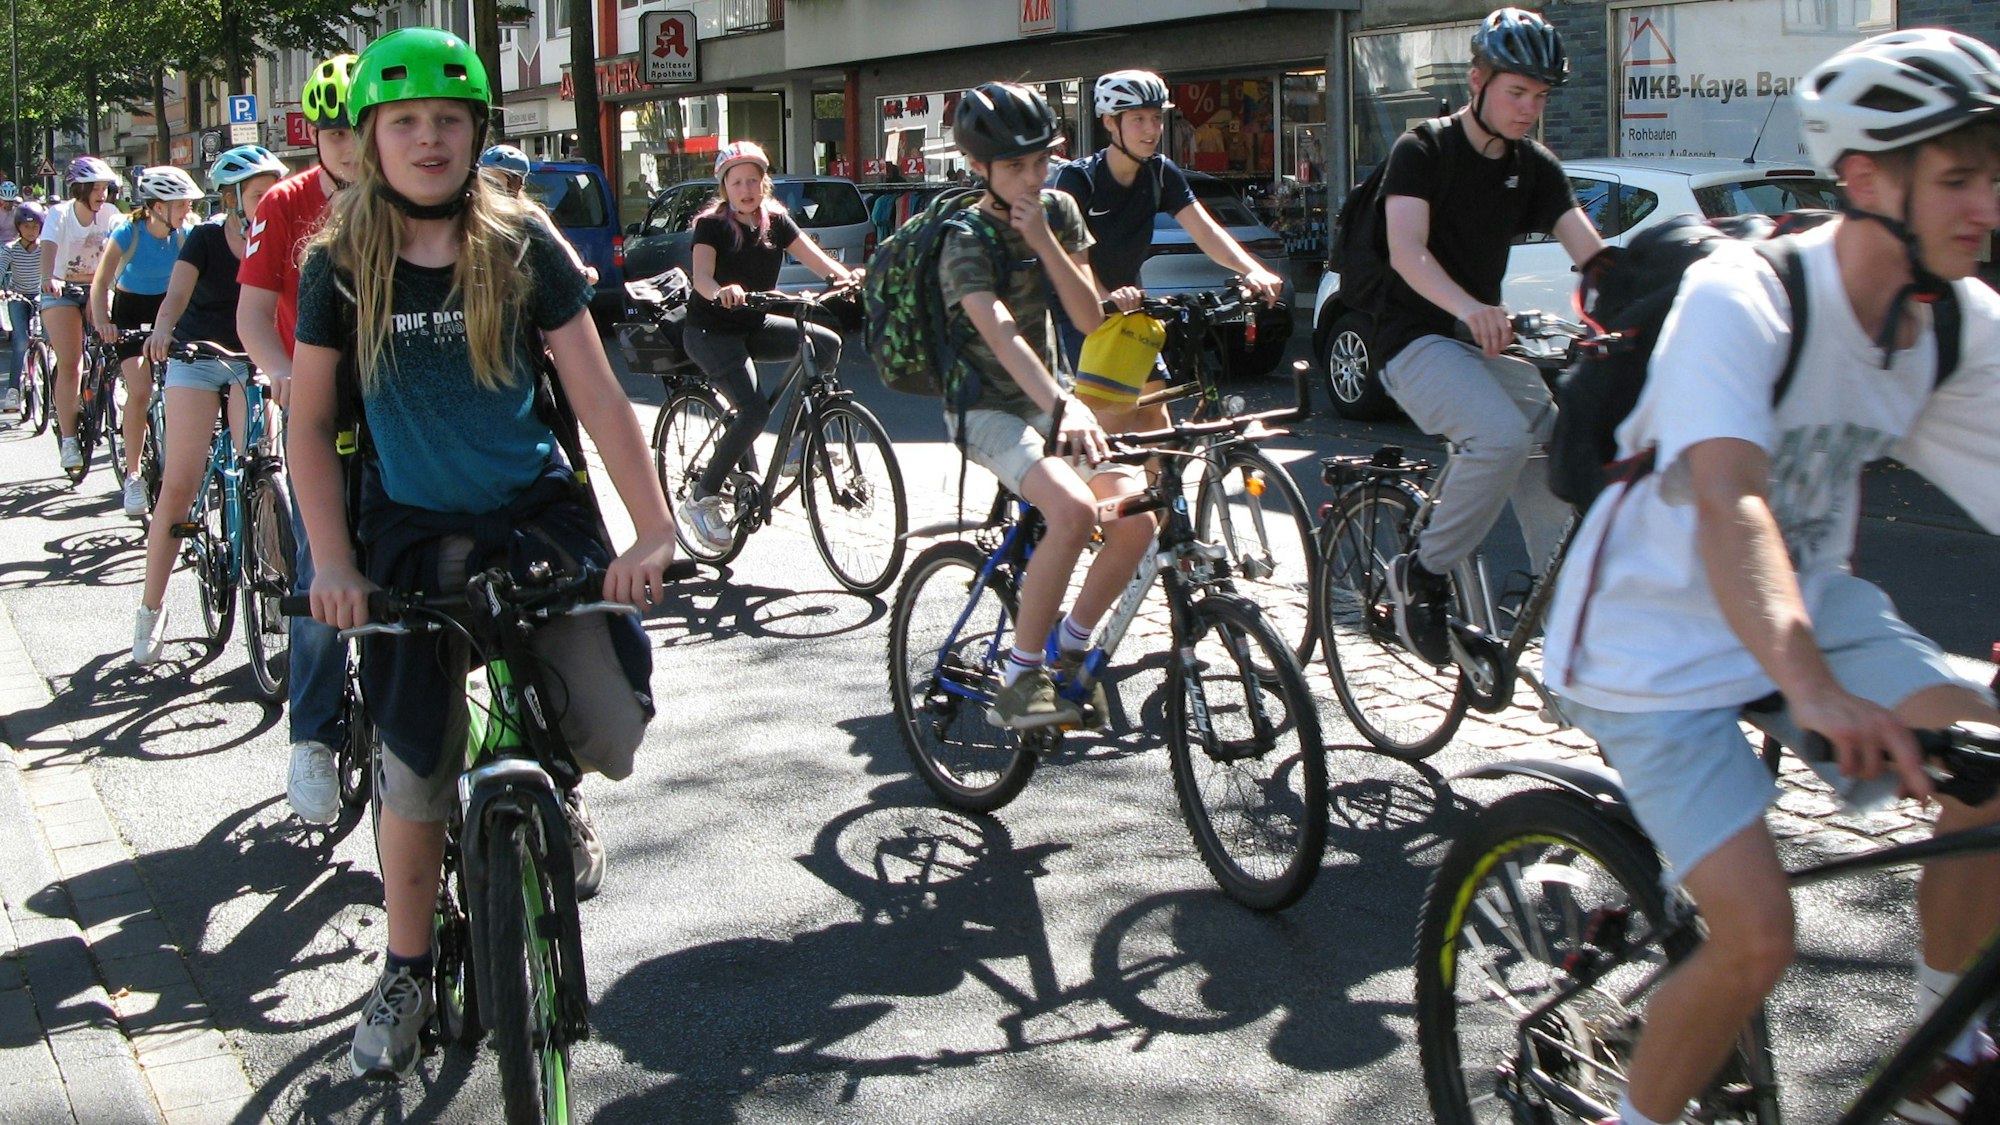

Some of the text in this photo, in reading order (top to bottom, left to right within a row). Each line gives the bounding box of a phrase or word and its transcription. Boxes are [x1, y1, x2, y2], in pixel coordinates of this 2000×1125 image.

[652, 61, 691, 69] Malteser
[560, 61, 655, 100] ATHEK
[651, 70, 692, 79] Apotheke
[1628, 73, 1748, 104] MKB-Kaya
[235, 98, 250, 120] P
[1628, 128, 1677, 141] Rohbauten
